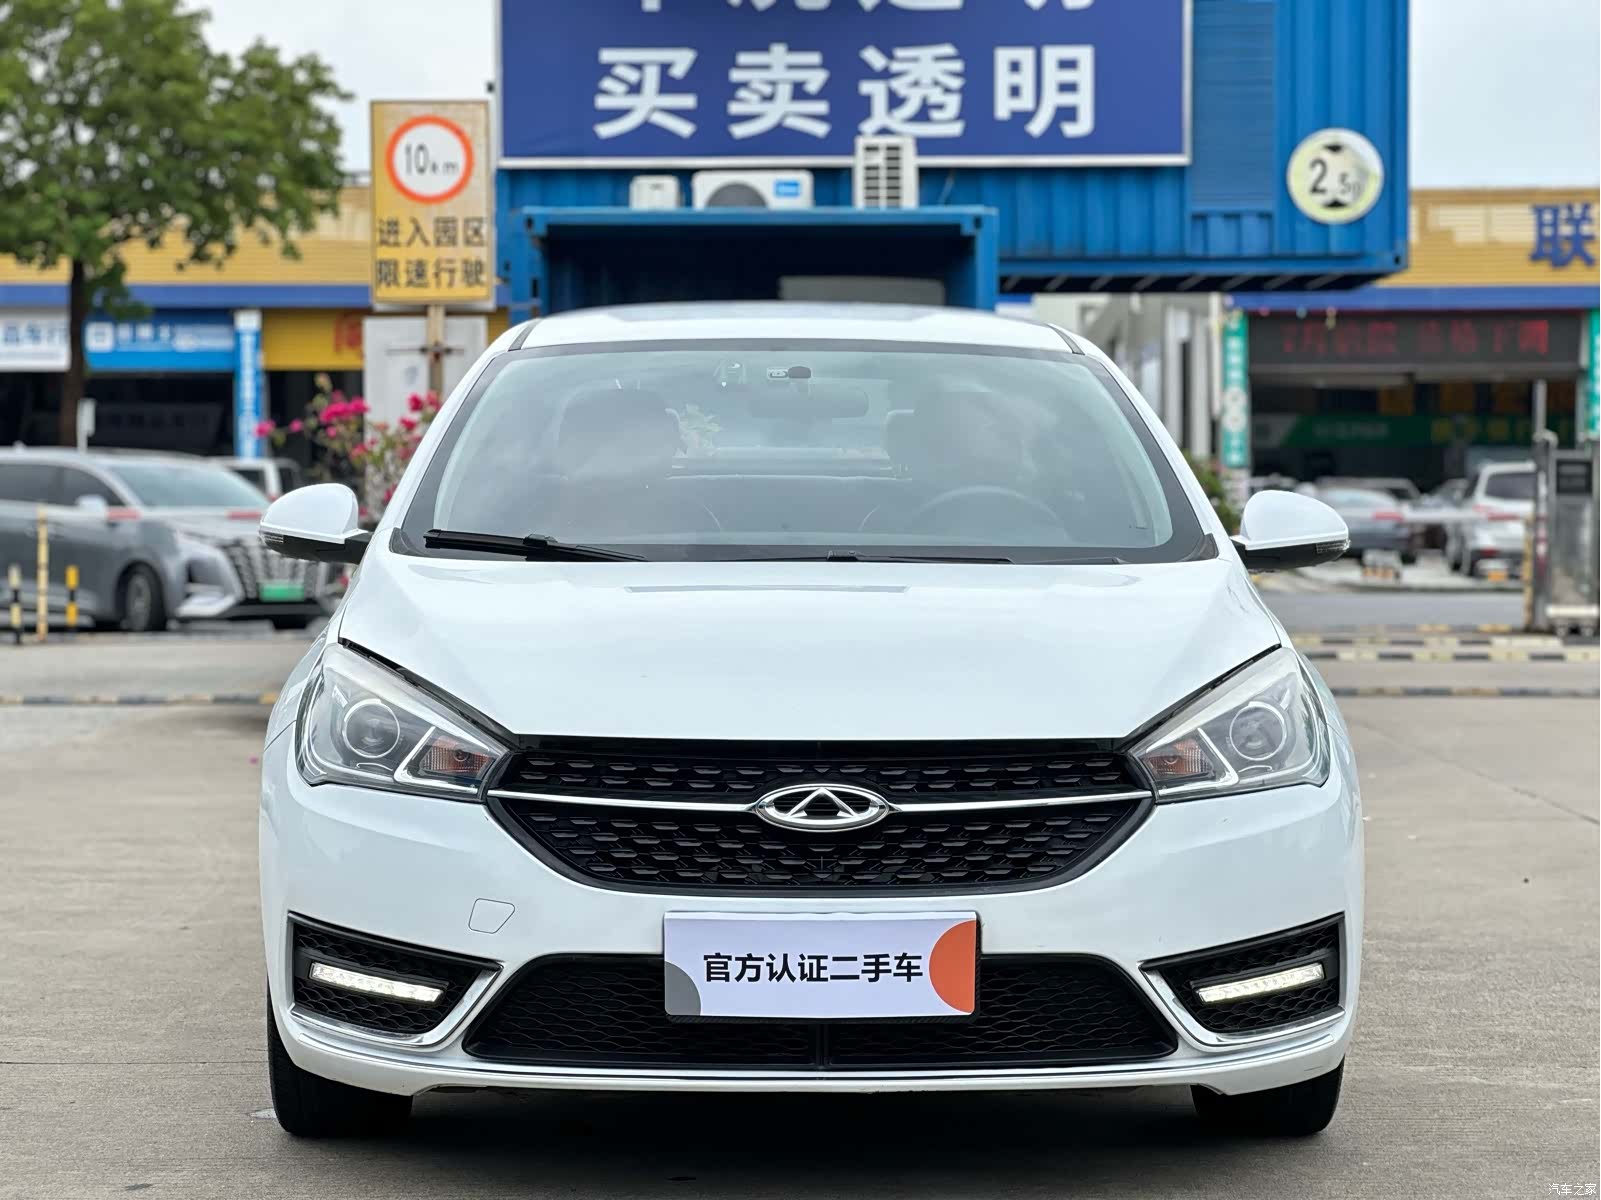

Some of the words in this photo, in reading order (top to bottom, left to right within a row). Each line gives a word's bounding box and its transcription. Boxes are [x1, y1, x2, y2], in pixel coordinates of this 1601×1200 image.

[594, 43, 1096, 138] 买卖透明
[377, 216, 486, 247] 进入园区
[376, 257, 486, 288] 限速行驶
[703, 952, 923, 983] 官方认证二手车
